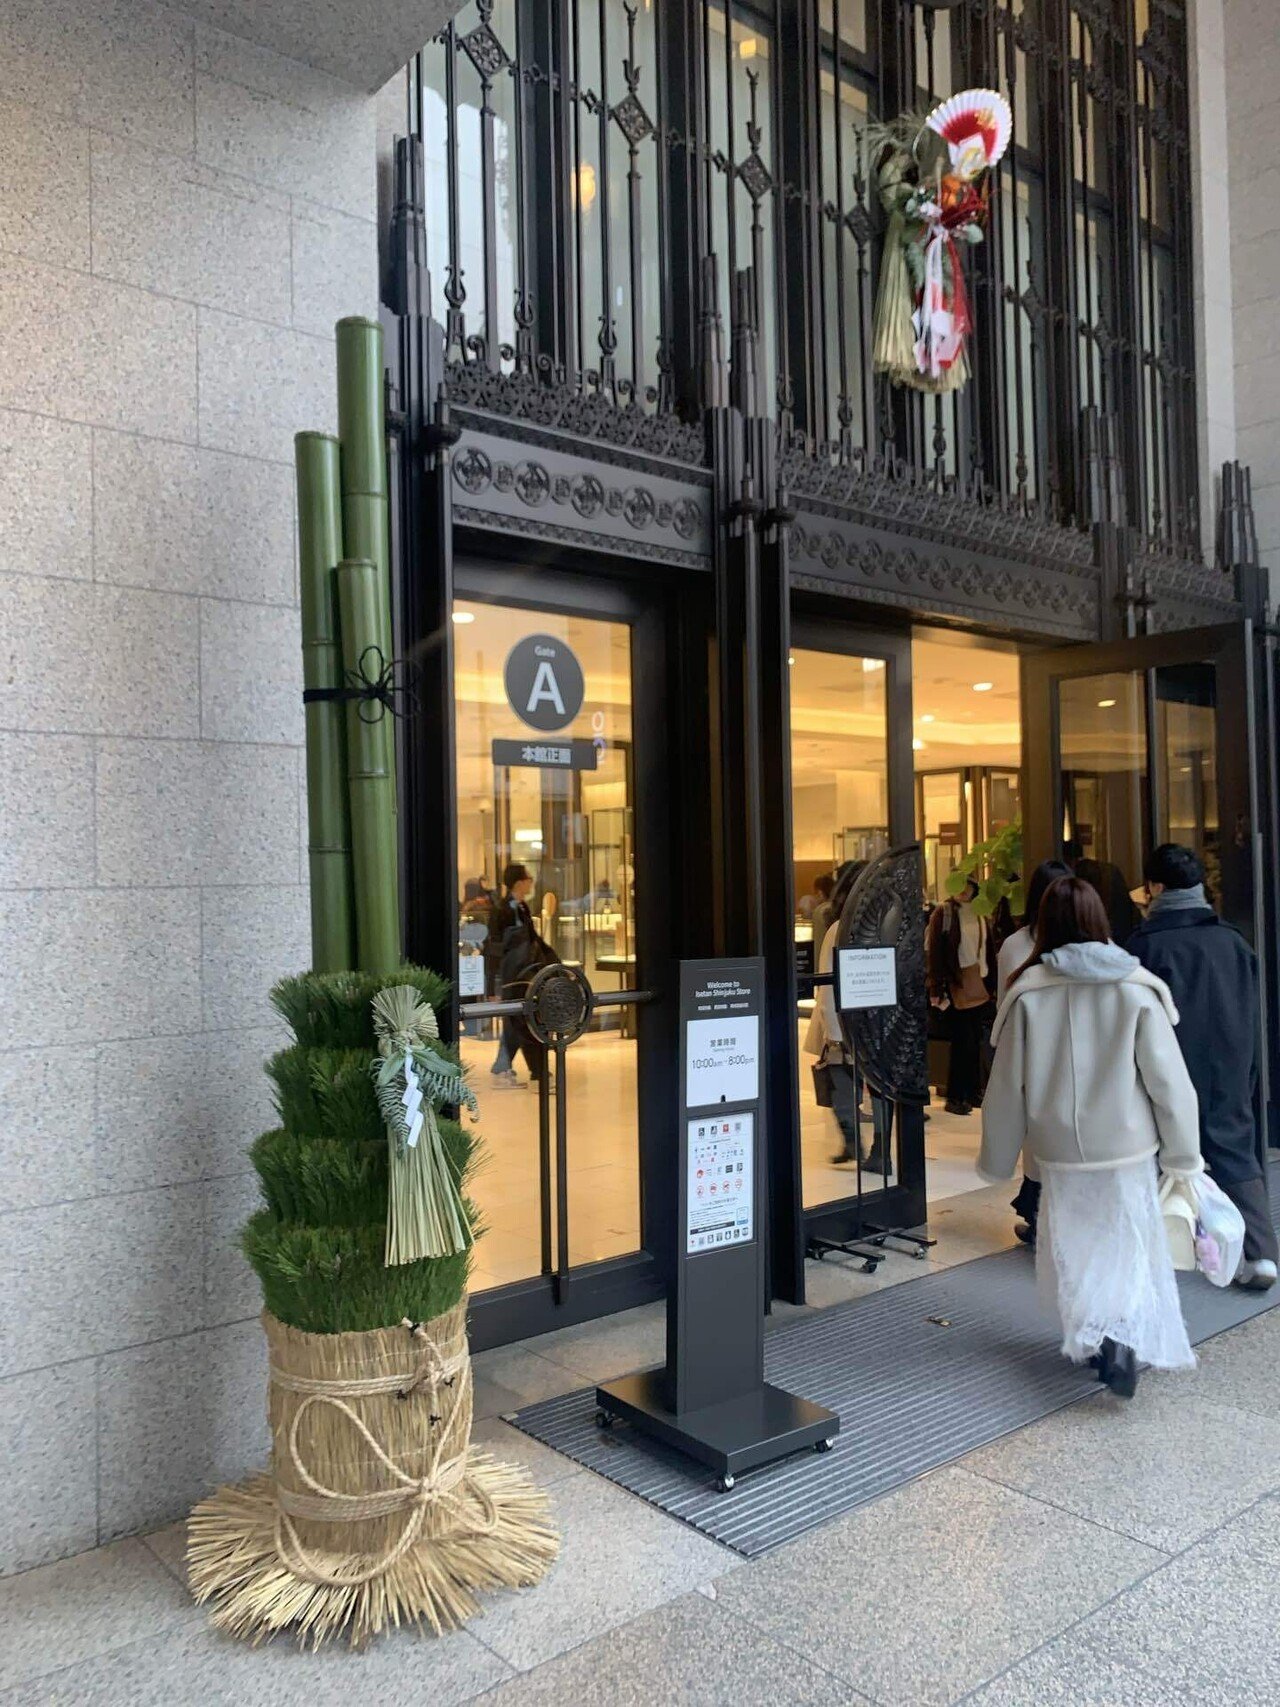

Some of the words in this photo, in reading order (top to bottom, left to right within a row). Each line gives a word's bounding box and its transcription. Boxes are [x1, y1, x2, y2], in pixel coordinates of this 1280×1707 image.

[534, 645, 556, 658] Gate
[526, 661, 566, 715] A
[707, 981, 733, 989] Welcome
[695, 990, 712, 998] Isetan
[713, 988, 736, 998] Shinjuku
[736, 988, 751, 996] Store
